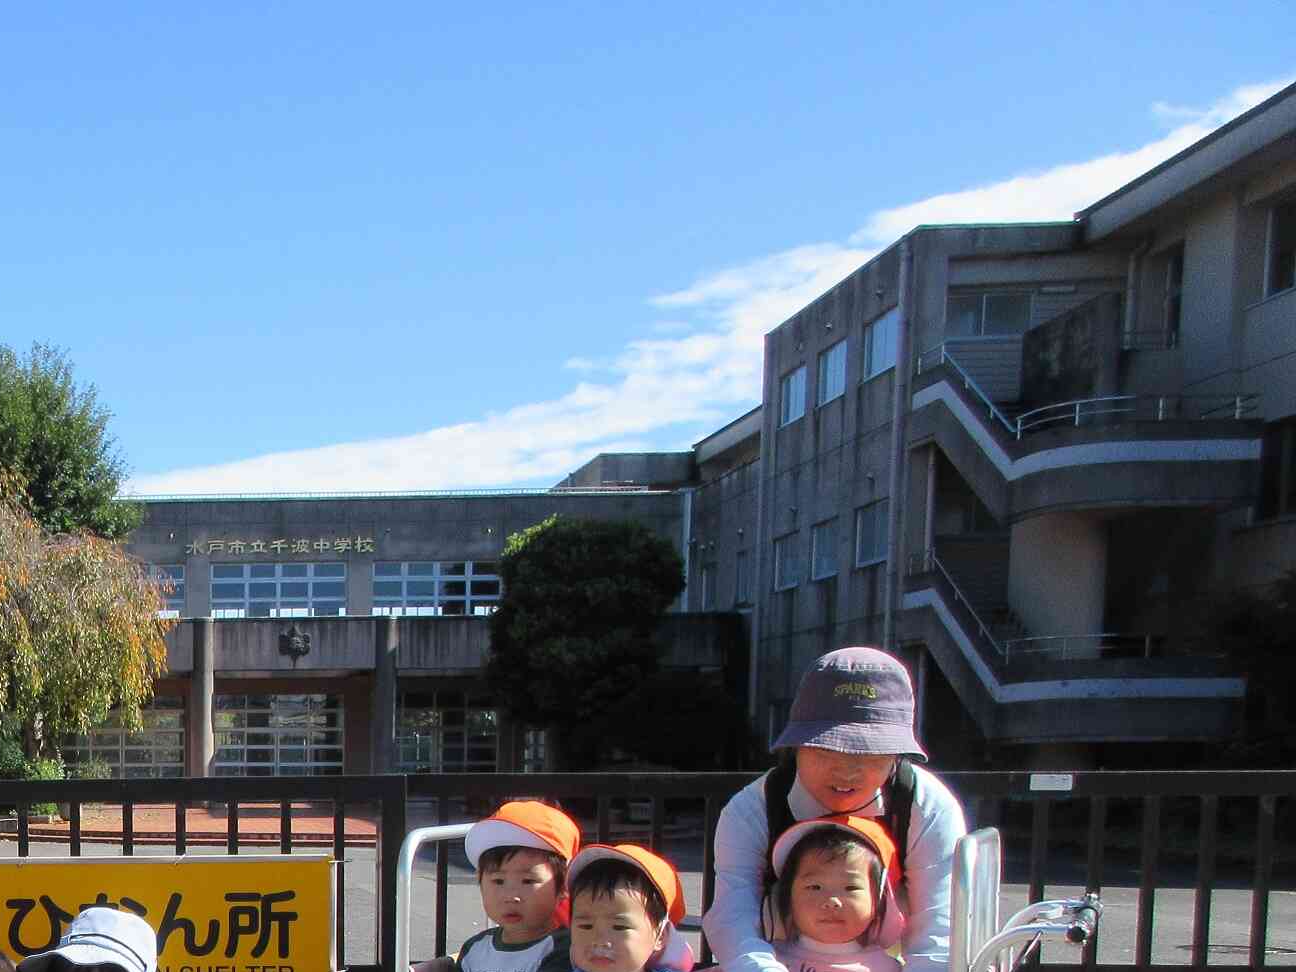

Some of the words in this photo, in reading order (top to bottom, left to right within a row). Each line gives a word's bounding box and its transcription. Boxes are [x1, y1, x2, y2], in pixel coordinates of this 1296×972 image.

[185, 535, 375, 556] 水戸市立千波中学校
